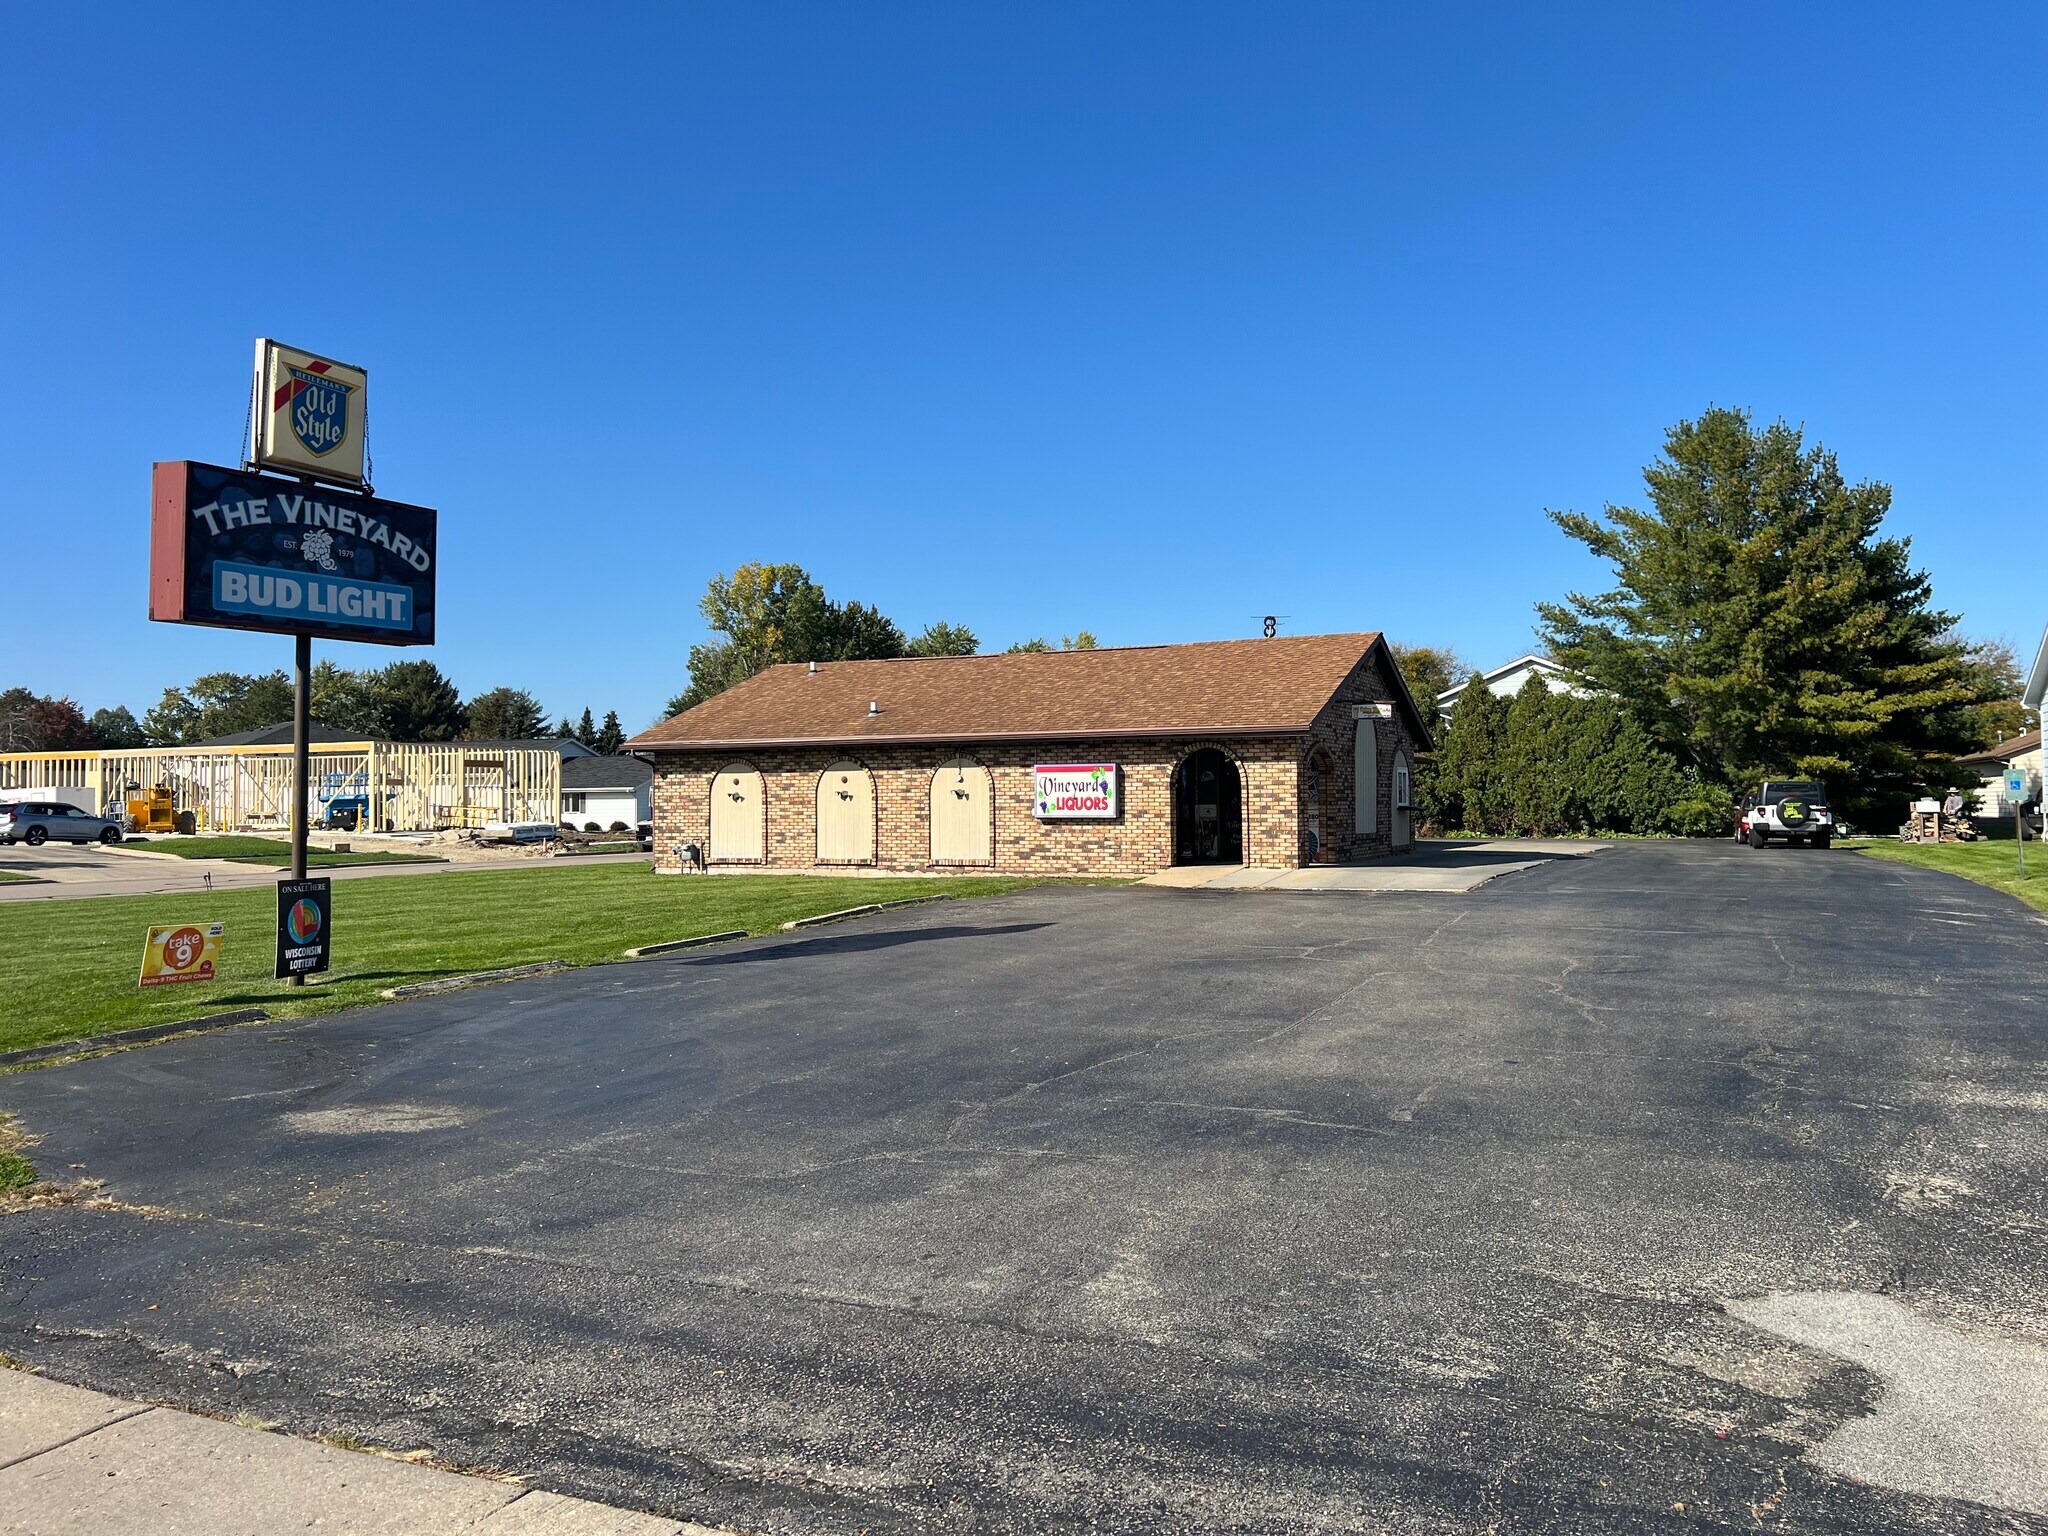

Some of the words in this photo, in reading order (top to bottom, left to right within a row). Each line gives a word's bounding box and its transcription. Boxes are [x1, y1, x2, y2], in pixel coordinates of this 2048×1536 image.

[296, 371, 346, 391] HEILEMAN'S
[306, 386, 337, 416] Old
[296, 405, 341, 448] Style
[193, 497, 271, 537] THE
[276, 494, 431, 572] VINEYARD
[283, 540, 298, 550] EST.
[338, 549, 354, 559] 1979
[221, 570, 303, 610] BUD
[308, 581, 407, 622] LIGHT
[1039, 775, 1100, 799] Vineyard
[1056, 796, 1109, 811] LIQUORS
[282, 886, 293, 894] ON
[293, 884, 309, 893] SALE
[310, 883, 326, 892] HERE
[169, 934, 200, 950] take
[176, 944, 193, 967] 9
[285, 945, 322, 959] WISCONSIN
[289, 957, 317, 970] LOTTERY
[142, 977, 165, 985] Delta-9
